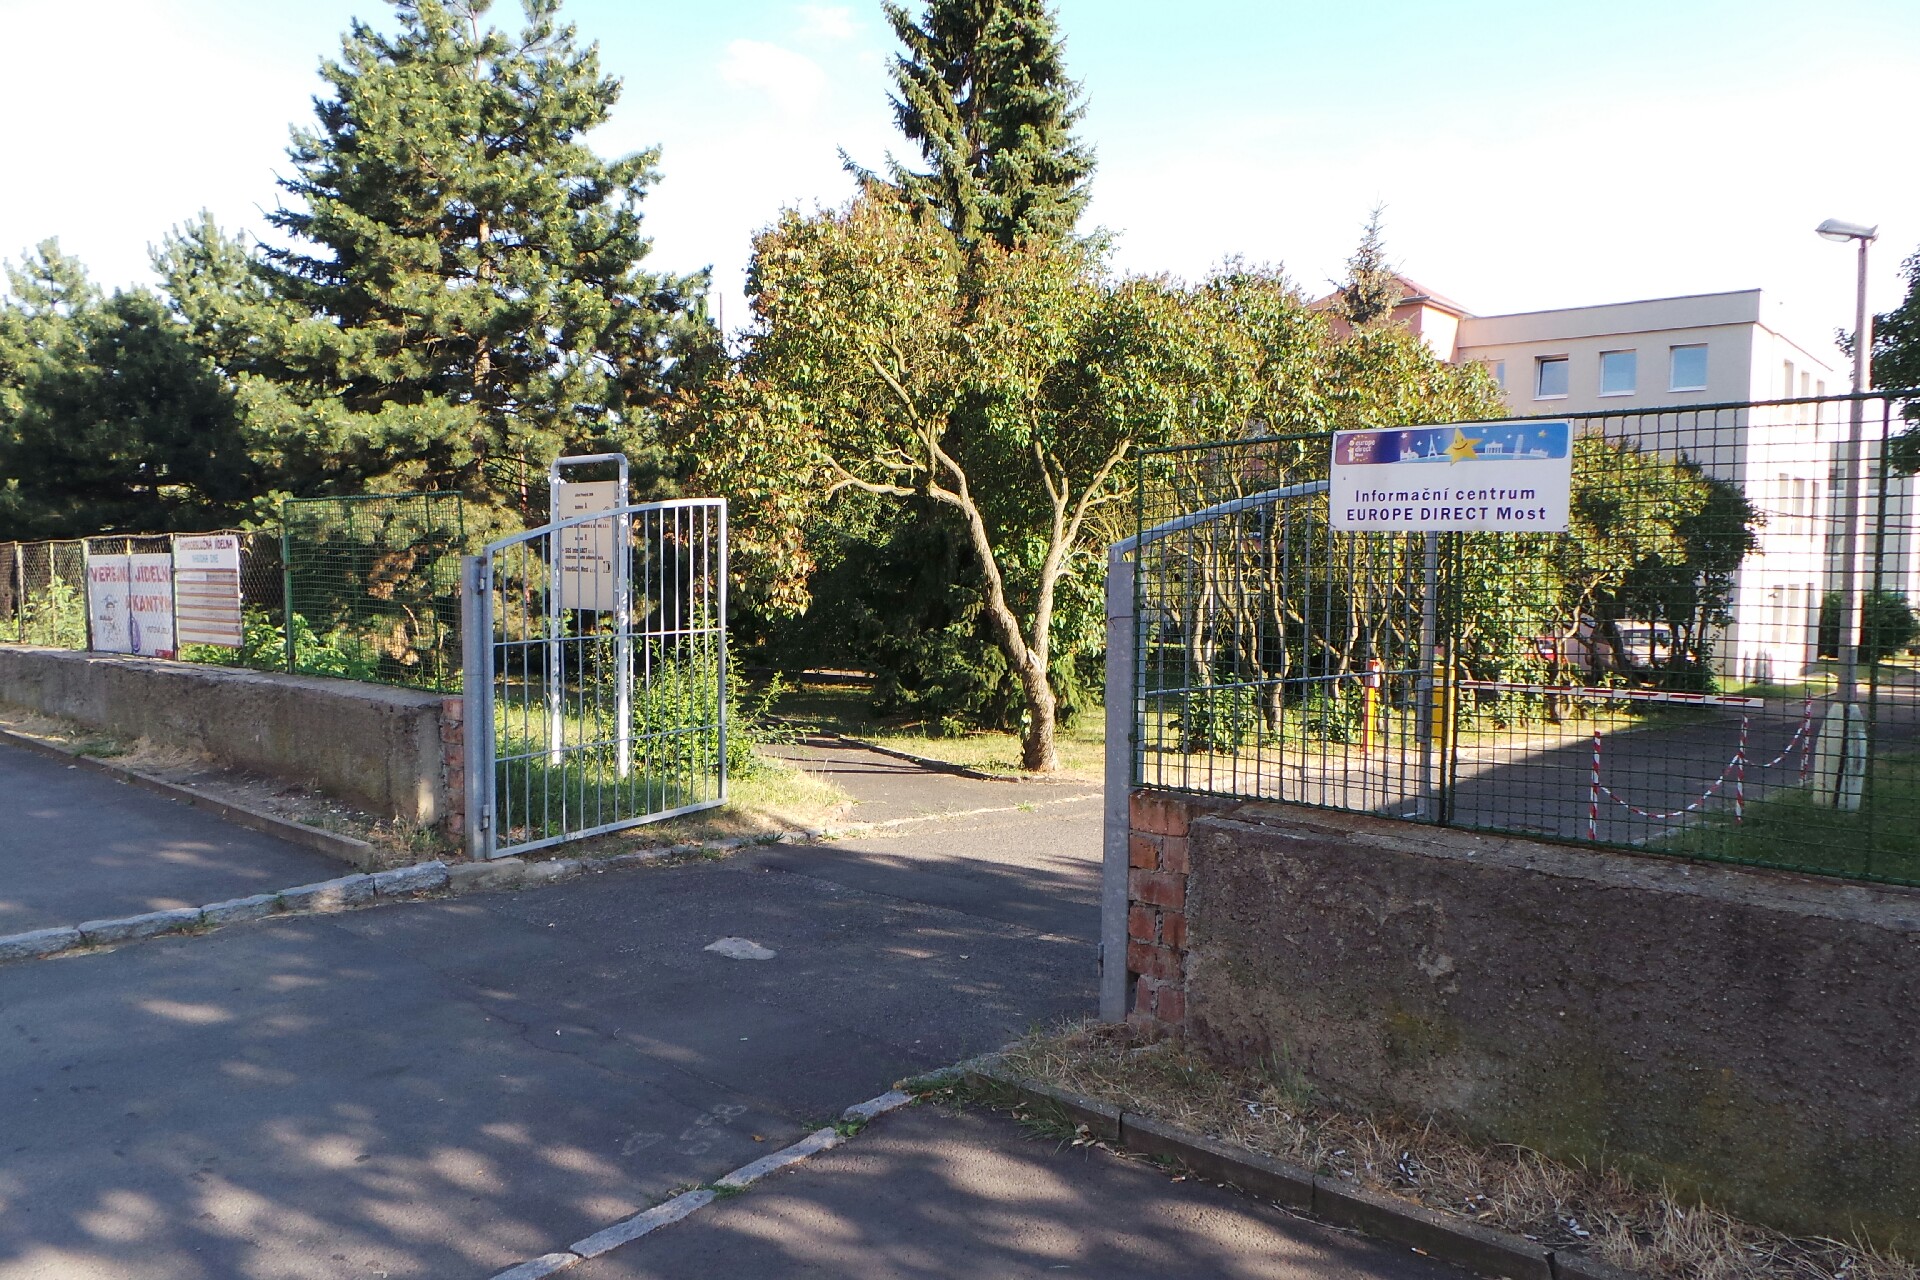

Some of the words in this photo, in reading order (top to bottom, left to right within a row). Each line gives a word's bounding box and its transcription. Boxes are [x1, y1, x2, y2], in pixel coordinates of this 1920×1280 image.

[1355, 439, 1376, 447] europe
[1355, 487, 1449, 503] Informační
[1455, 487, 1536, 501] centrum
[1346, 508, 1414, 521] EUROPE
[1420, 507, 1489, 521] DIRECT
[1496, 506, 1547, 521] Most
